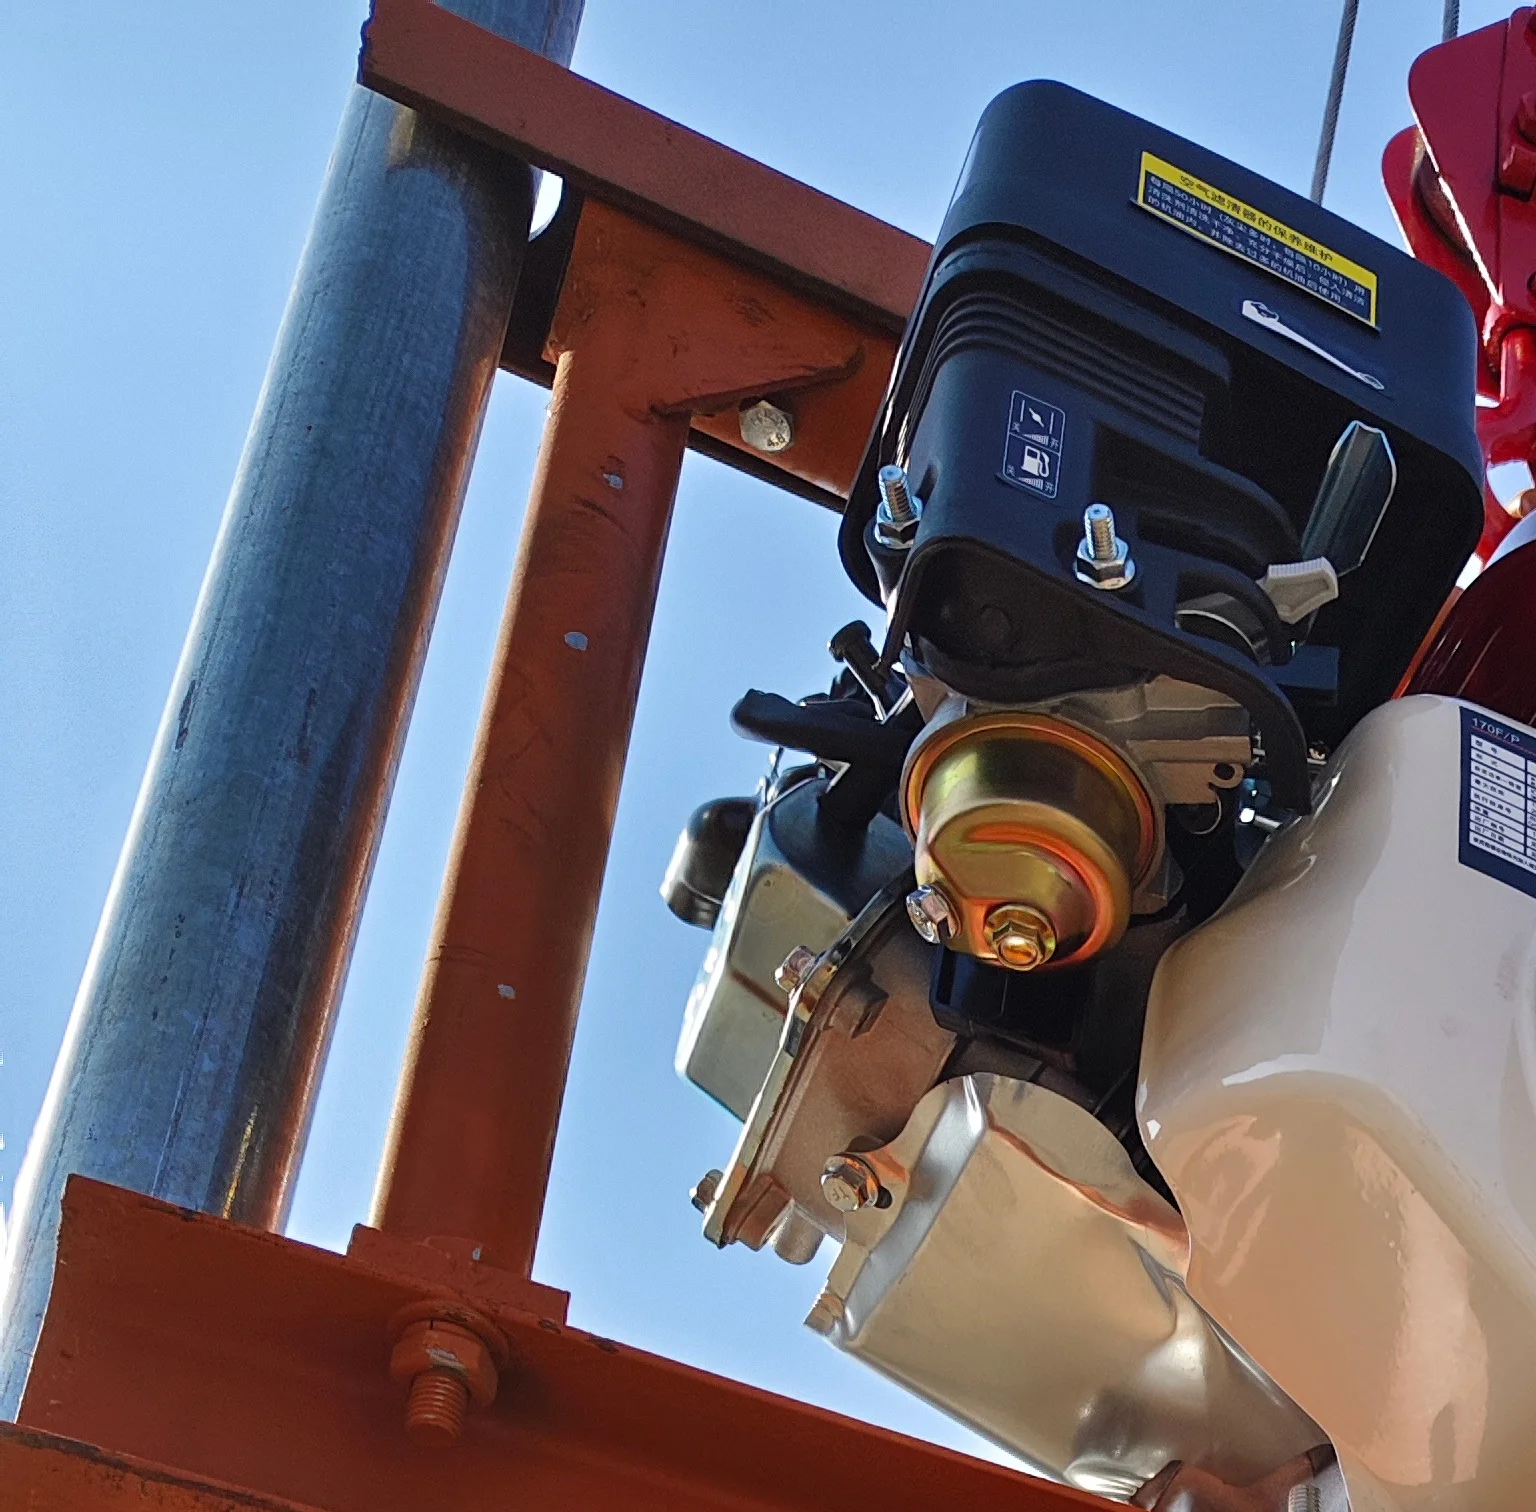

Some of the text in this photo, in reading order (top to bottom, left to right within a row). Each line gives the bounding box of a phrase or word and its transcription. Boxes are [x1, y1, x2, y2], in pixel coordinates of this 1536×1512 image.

[1179, 175, 1333, 262] 空气滤清器的保养维护
[1472, 717, 1520, 743] 170F/P
